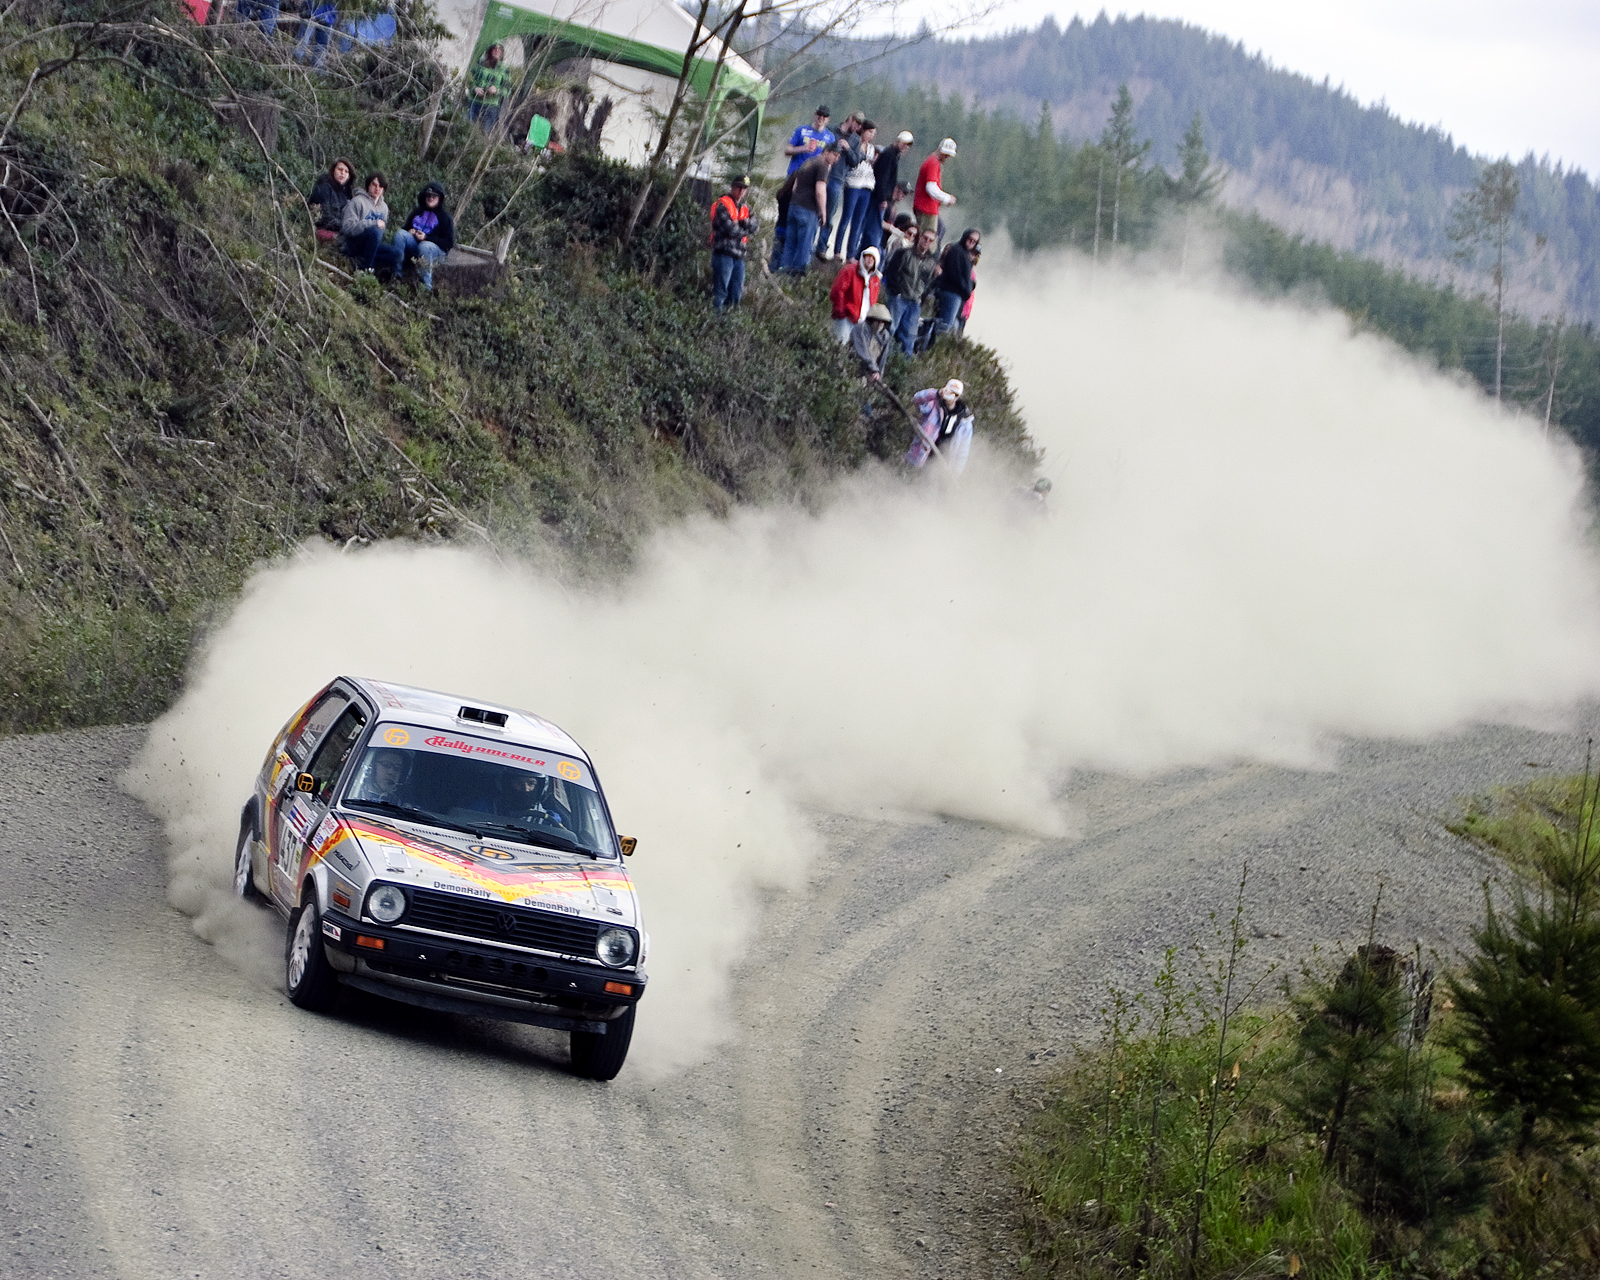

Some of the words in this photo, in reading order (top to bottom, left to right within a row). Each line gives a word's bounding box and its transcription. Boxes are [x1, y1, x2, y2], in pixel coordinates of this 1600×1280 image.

[424, 736, 473, 753] Rally
[433, 881, 491, 898] DemonRally
[524, 898, 580, 915] DemonRally
